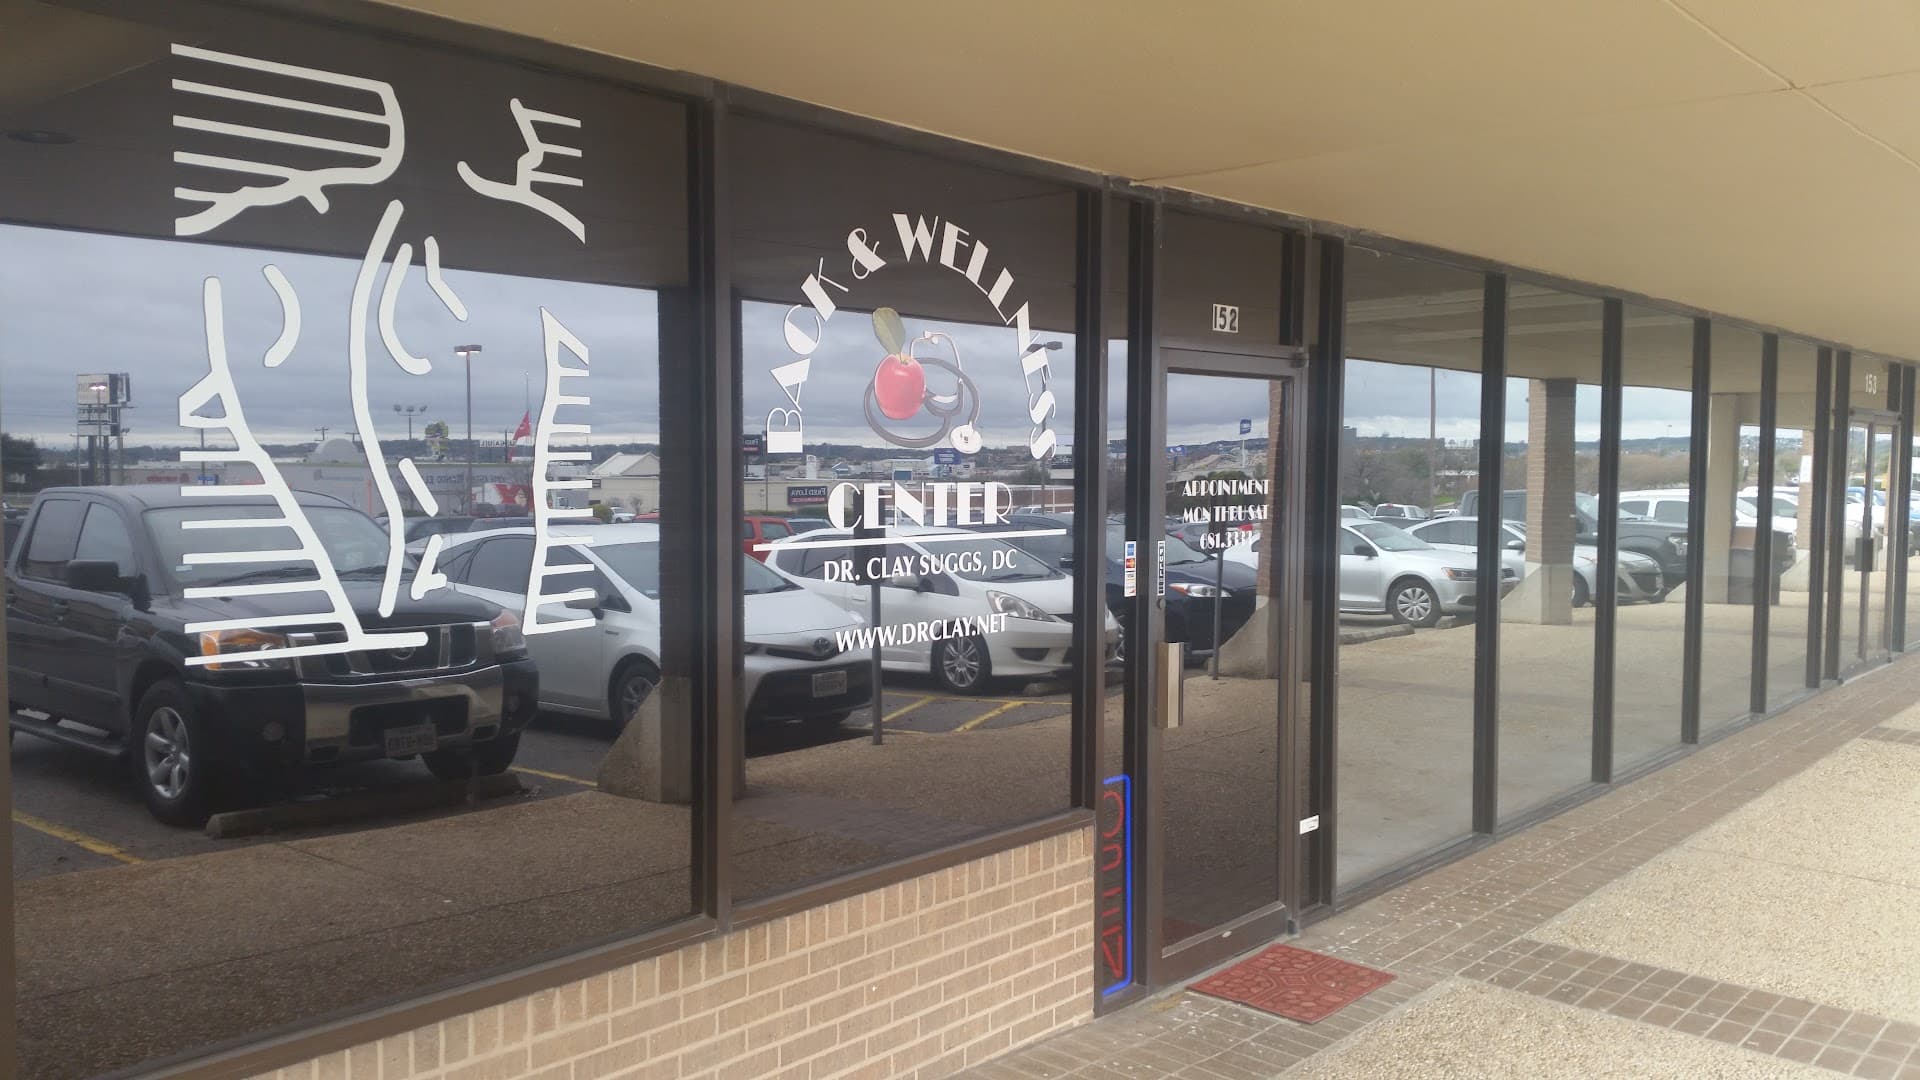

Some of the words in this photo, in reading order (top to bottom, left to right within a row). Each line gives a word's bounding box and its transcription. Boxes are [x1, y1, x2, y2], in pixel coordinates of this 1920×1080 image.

[1213, 306, 1237, 331] 152
[767, 257, 849, 454] BACK
[847, 228, 887, 279] &
[892, 213, 1057, 460] WELLNESS
[1865, 374, 1877, 394] 153
[1182, 479, 1270, 497] APPOINTMENT
[827, 482, 1013, 530] CENTER
[1182, 507, 1211, 522] MON
[1213, 505, 1247, 521] THRU
[1247, 504, 1270, 520] SAT
[823, 560, 860, 583] DR.
[866, 555, 915, 580] CLAY
[919, 551, 988, 576] SUGGS,
[992, 548, 1017, 570] DC
[835, 612, 1009, 653] WWW.DRCLAY.NET
